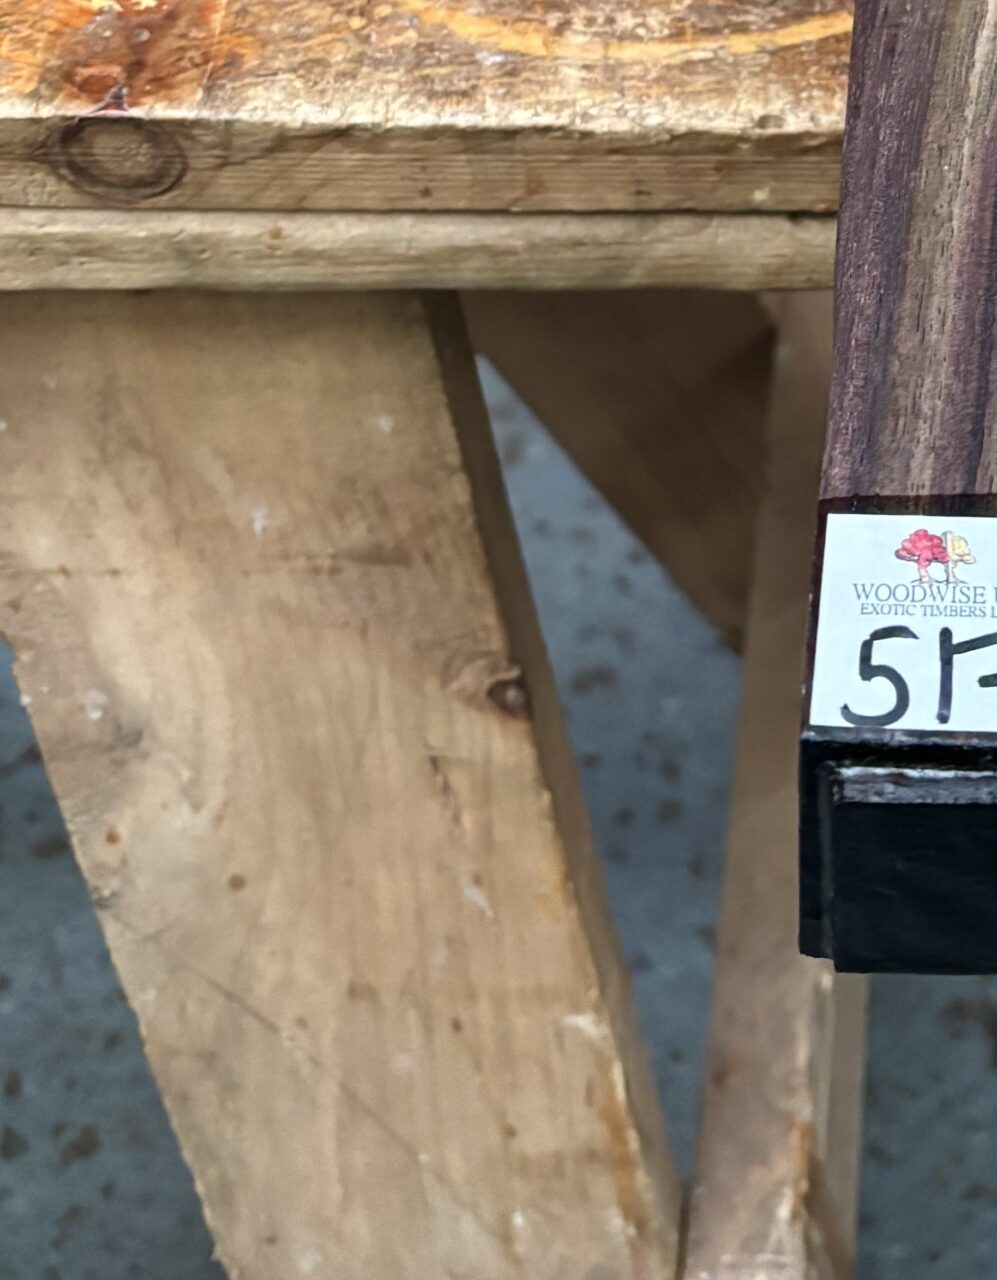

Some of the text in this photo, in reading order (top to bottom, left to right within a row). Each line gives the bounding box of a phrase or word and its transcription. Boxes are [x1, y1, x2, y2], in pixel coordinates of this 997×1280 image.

[853, 583, 986, 604] WOODWISE
[860, 603, 917, 616] EXOTIC
[921, 604, 987, 618] TIMBERS
